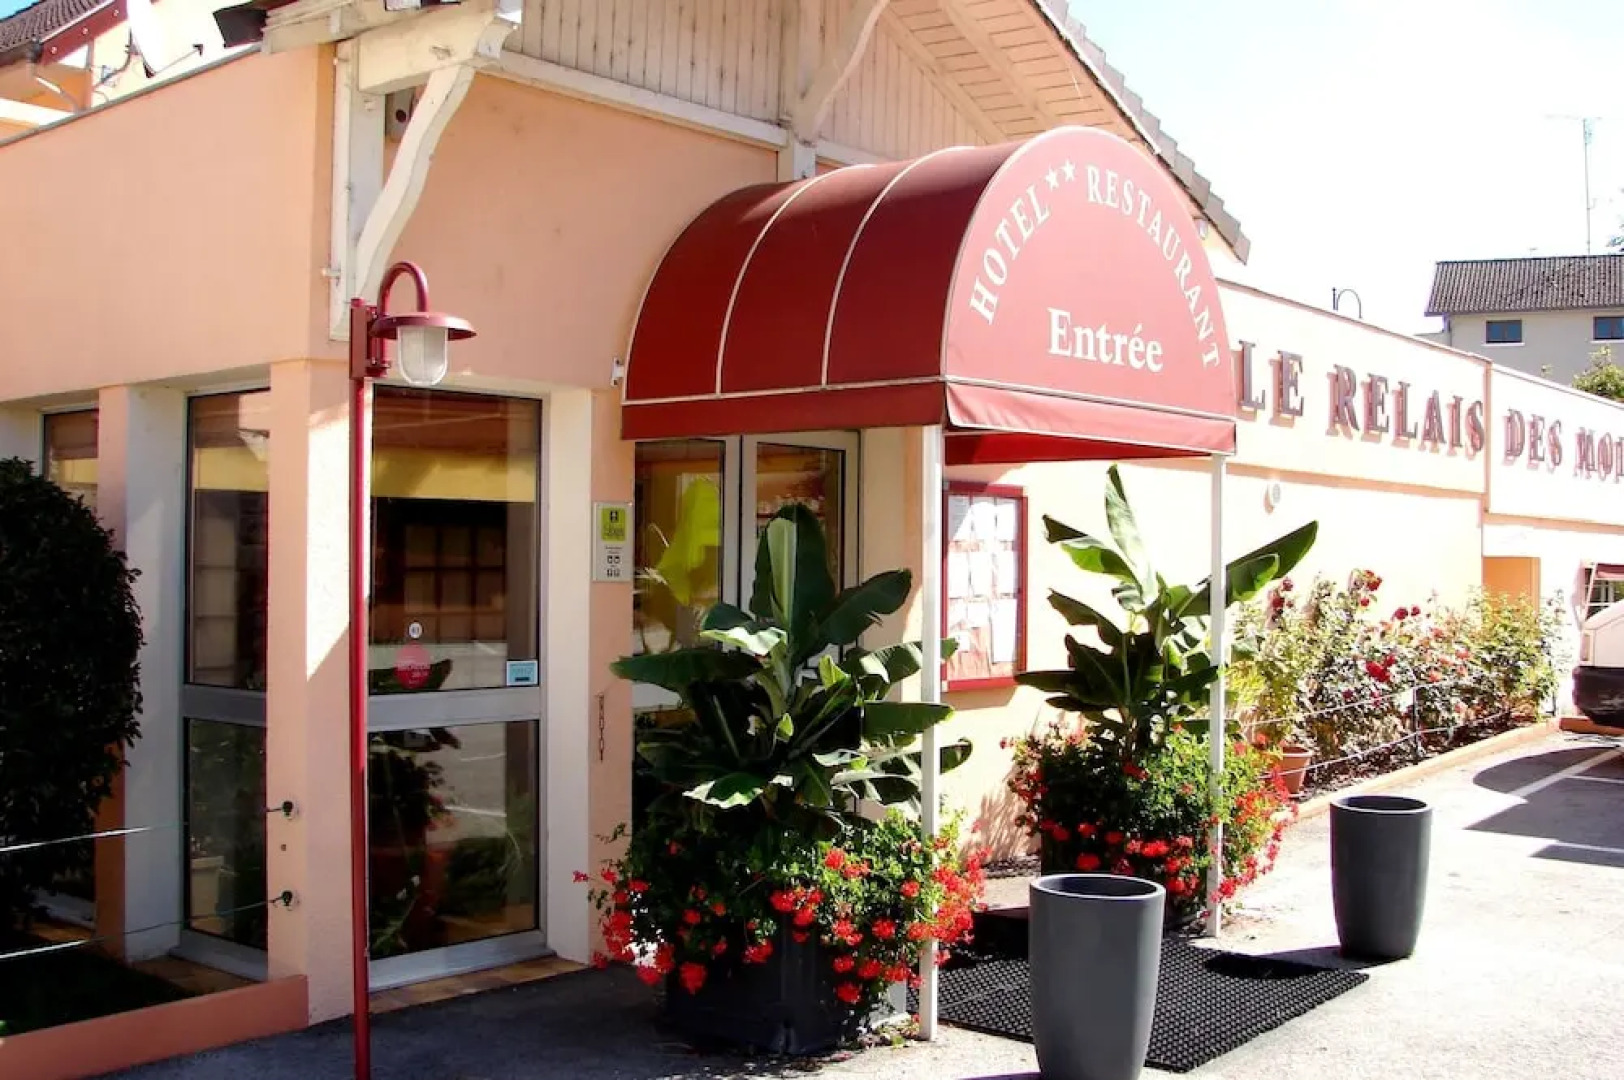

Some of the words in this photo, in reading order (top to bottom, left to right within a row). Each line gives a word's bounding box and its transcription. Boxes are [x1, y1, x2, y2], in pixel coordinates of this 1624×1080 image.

[969, 184, 1050, 325] HOTEL
[1085, 164, 1220, 368] RESTAURANT
[1047, 307, 1164, 373] Entrée
[1237, 340, 1304, 418] LE
[1332, 364, 1486, 453] RELAIS
[1505, 408, 1562, 466] DES
